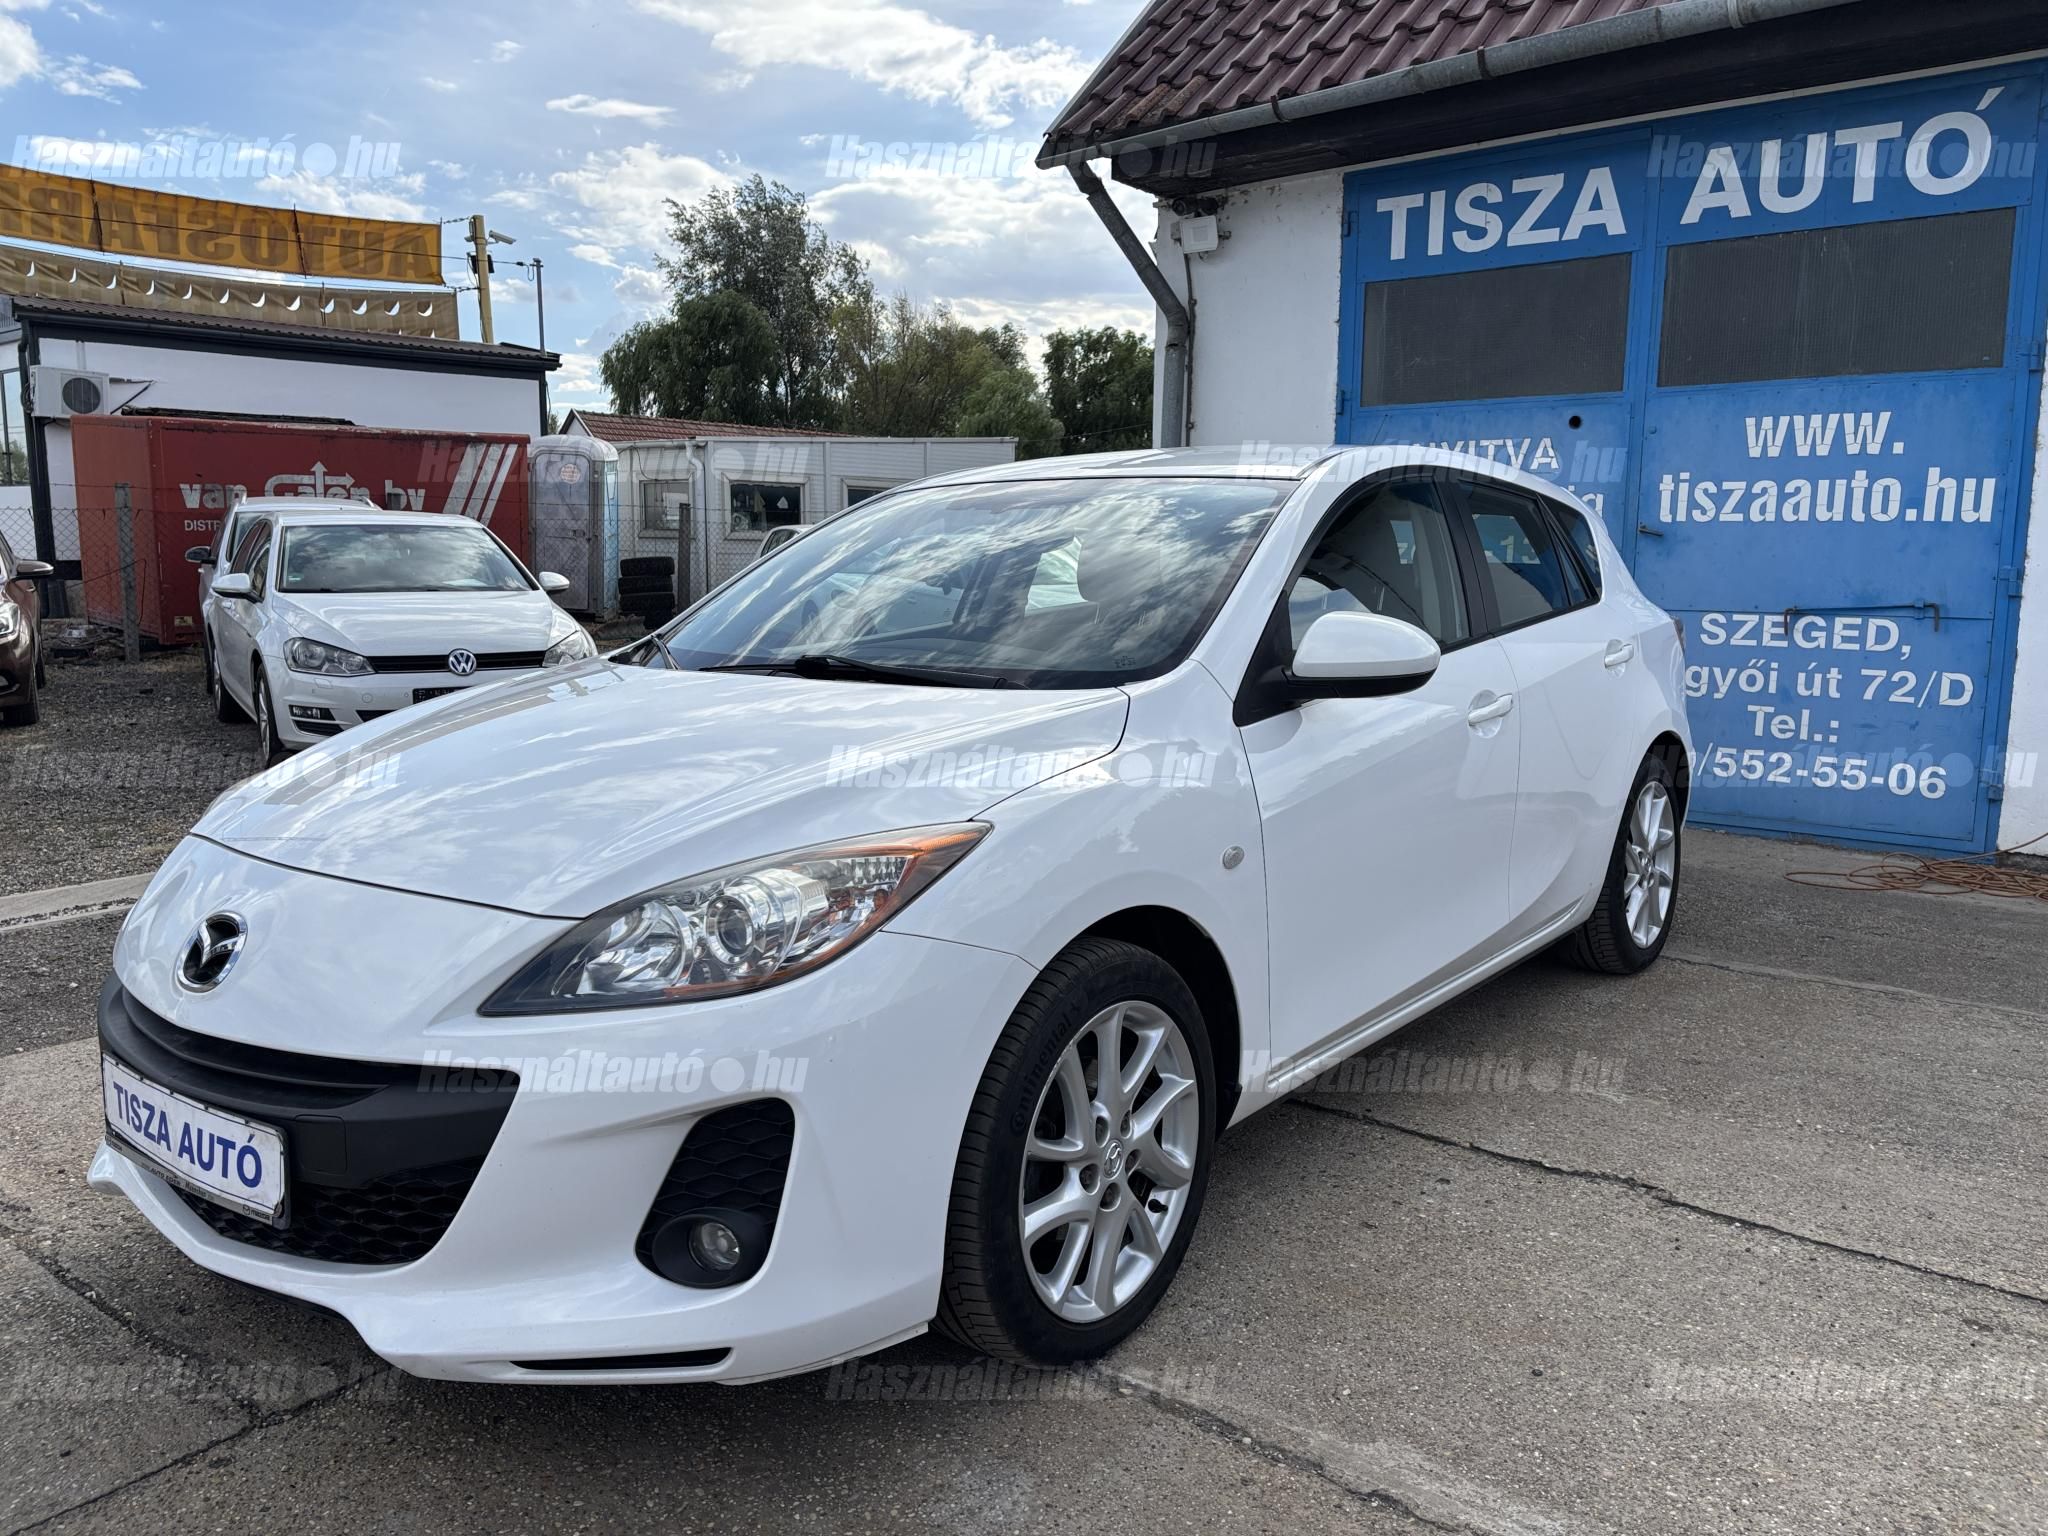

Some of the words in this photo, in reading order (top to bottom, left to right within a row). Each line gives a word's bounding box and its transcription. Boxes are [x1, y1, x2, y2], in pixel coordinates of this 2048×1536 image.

[1376, 166, 1627, 260] TISZA
[1679, 86, 2004, 225] AUTÓ
[1745, 411, 1905, 458] www.
[1659, 466, 1997, 523] tiszaauto.hu
[1700, 612, 1912, 660] SZEGED,
[1796, 662, 1843, 698] út
[1860, 668, 1974, 708] 72/D
[1747, 704, 1840, 743] Tel.:
[1691, 742, 1947, 800] /552-55-06
[113, 1081, 171, 1152] TISZA
[178, 1121, 262, 1189] AUTÓ
